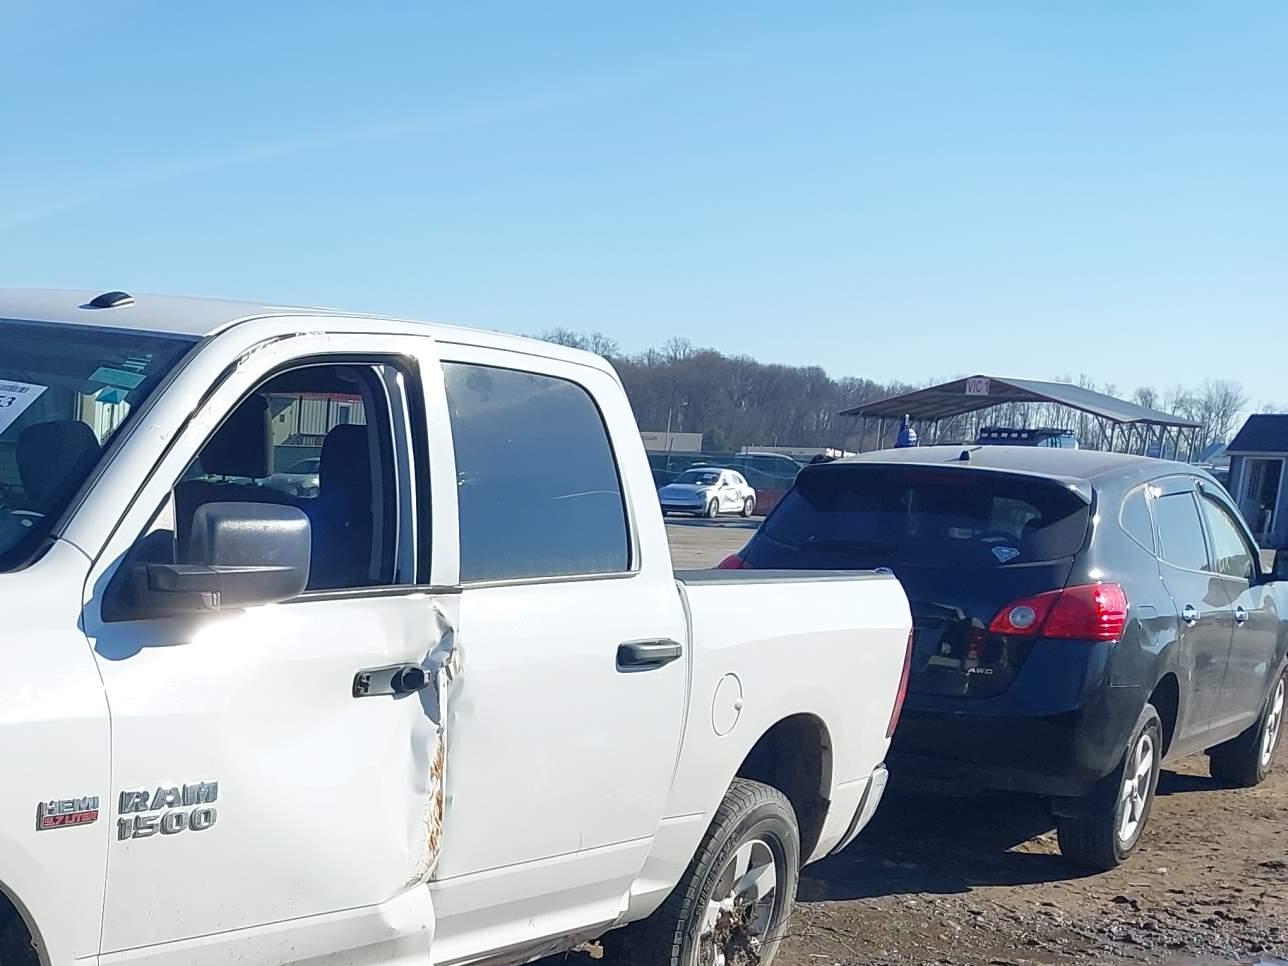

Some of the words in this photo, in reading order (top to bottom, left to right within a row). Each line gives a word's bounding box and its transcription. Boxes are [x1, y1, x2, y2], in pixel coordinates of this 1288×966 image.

[967, 667, 993, 675] AWD
[40, 796, 99, 817] HEMI
[118, 781, 218, 814] RAM
[117, 807, 217, 841] 1500
